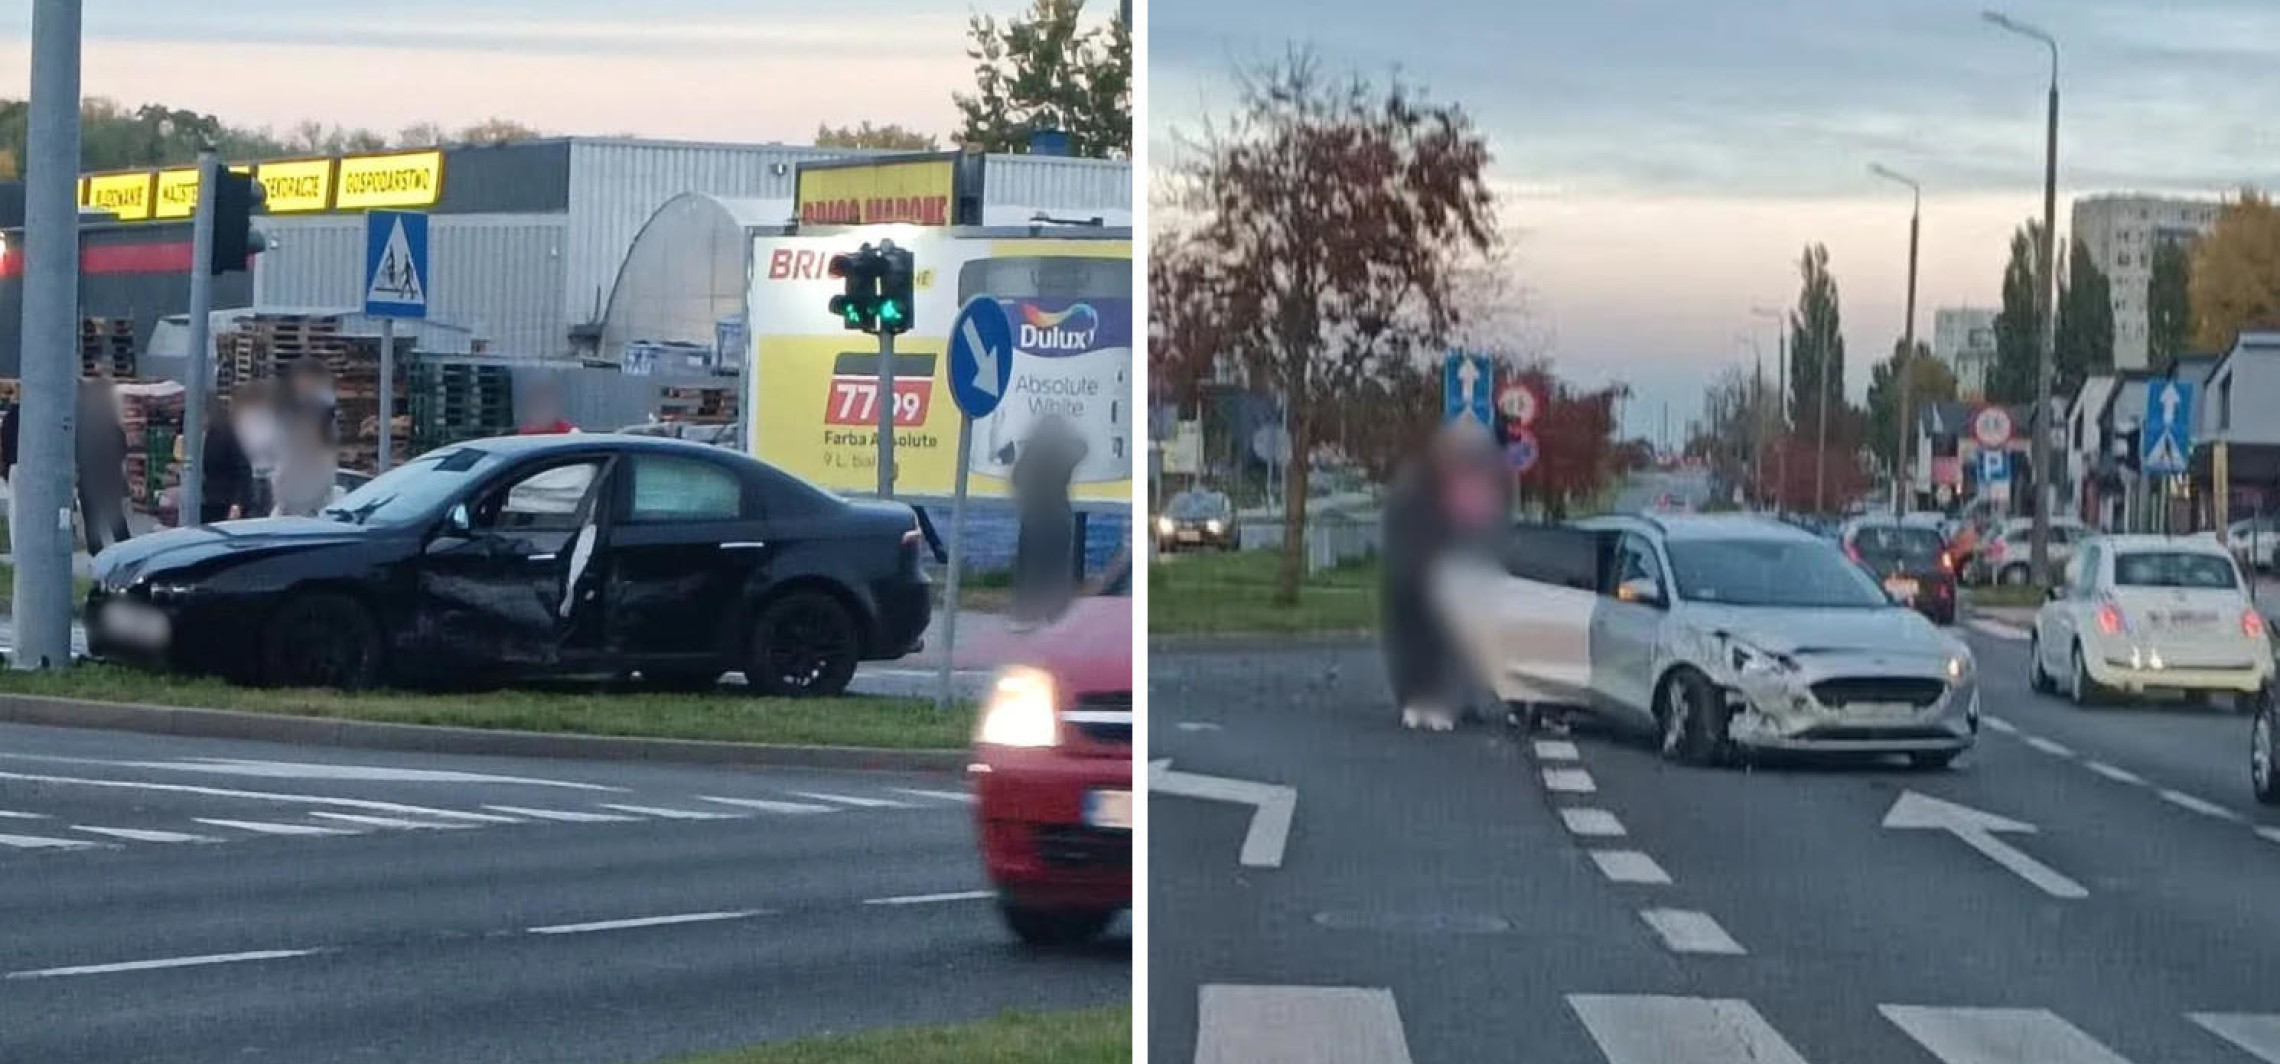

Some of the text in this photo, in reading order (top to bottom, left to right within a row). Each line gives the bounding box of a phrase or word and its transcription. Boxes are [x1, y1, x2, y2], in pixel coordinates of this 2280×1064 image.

[345, 167, 430, 196] GOSPODARSTWO
[768, 249, 834, 279] BRI
[1021, 323, 1086, 349] Dulux
[1016, 374, 1098, 397] Absolute
[836, 383, 878, 420] 77
[824, 430, 867, 446] Farba
